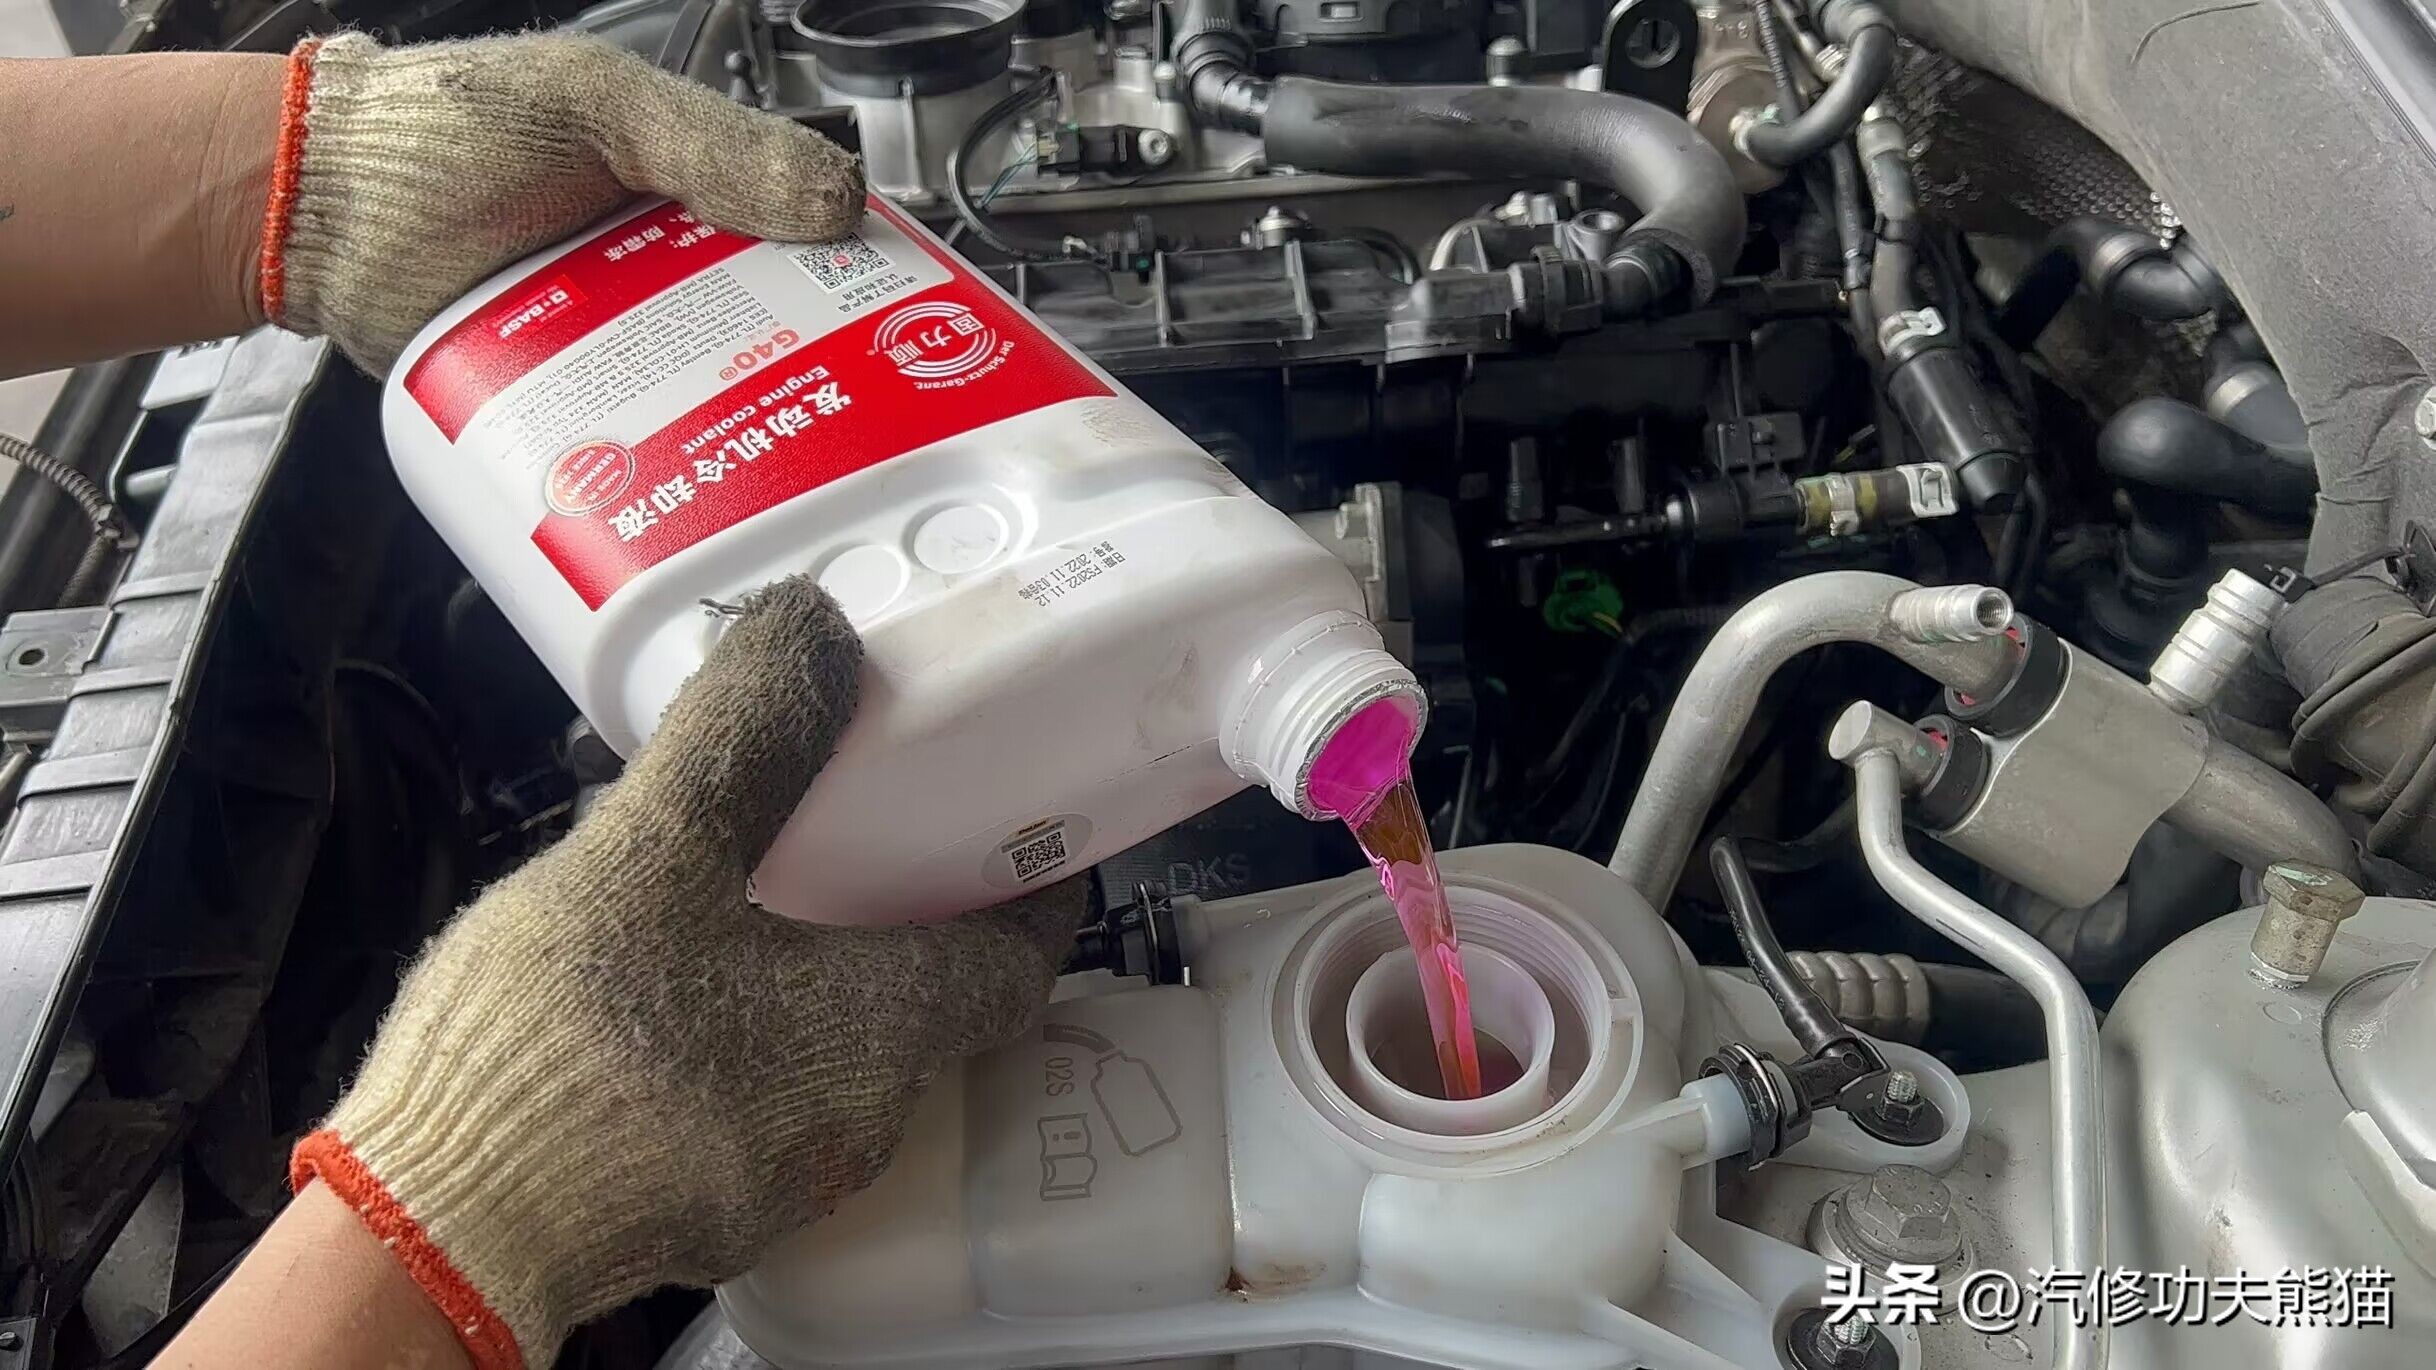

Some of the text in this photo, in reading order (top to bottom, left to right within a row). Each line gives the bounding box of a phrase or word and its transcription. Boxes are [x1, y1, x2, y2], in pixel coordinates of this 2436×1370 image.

[839, 276, 917, 312] 请扫码了解产品
[496, 302, 545, 338] BASF
[754, 313, 774, 326] Audi
[886, 313, 984, 367] 固力顺
[997, 341, 1015, 360] Der
[682, 366, 830, 455] Engine coolant
[608, 382, 852, 541] 发动机冷却液
[1098, 551, 1125, 570] 日期:
